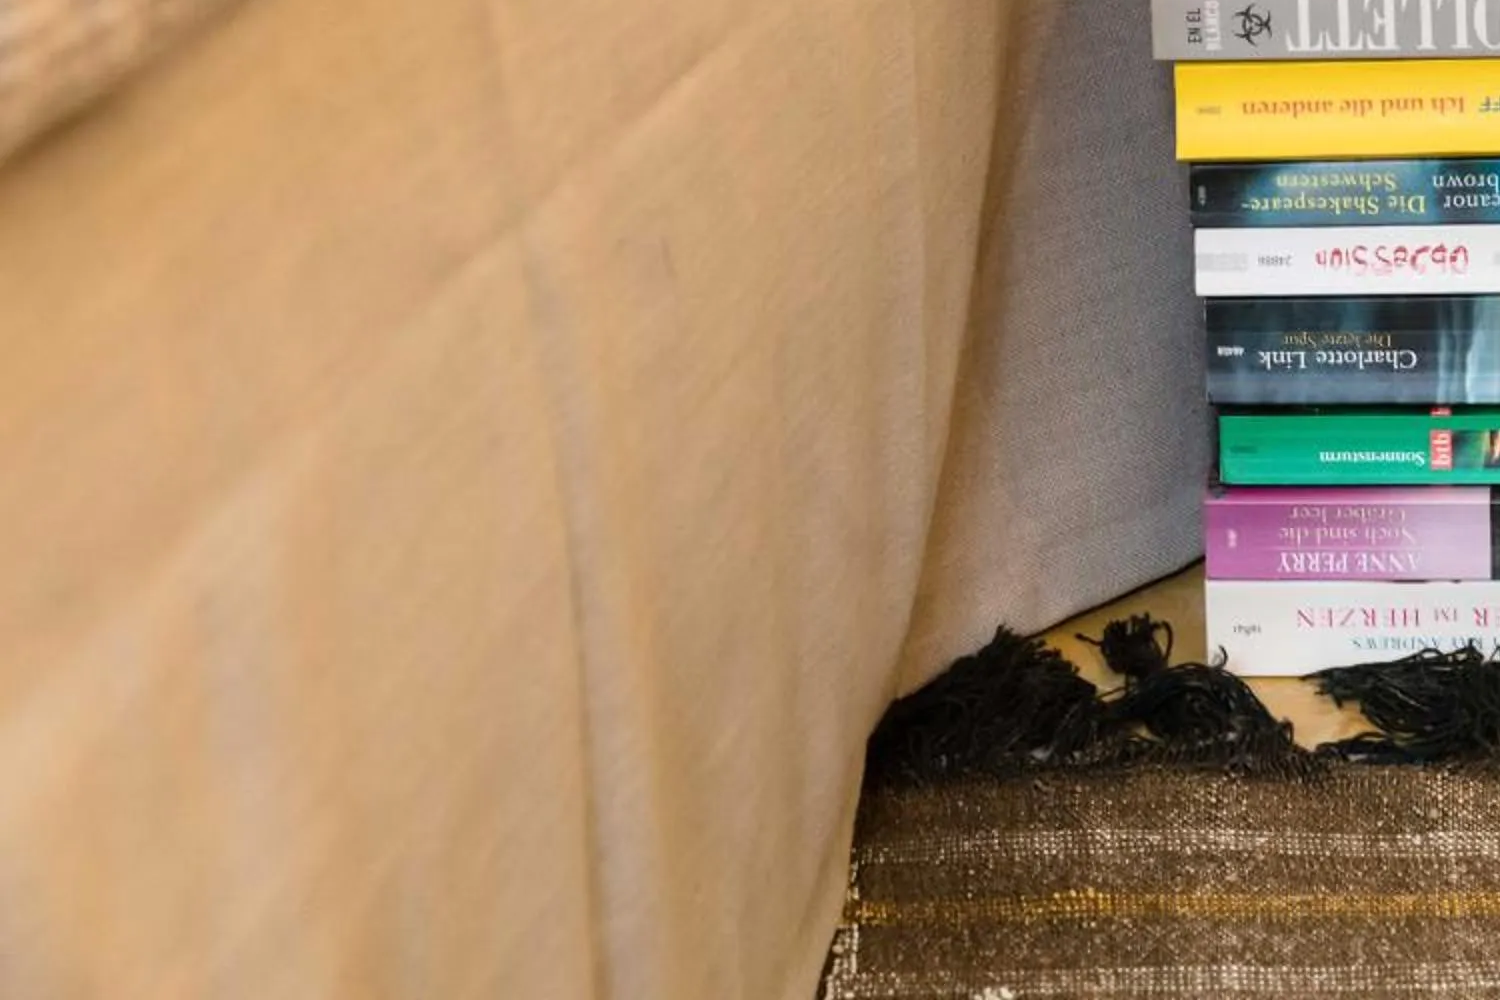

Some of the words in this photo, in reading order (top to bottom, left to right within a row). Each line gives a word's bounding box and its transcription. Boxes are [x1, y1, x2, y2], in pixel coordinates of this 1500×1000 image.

[1185, 8, 1201, 22] EL
[1188, 27, 1202, 44] EN
[1242, 100, 1334, 119] anderen
[1339, 98, 1373, 117] die
[1381, 98, 1423, 117] und
[1432, 97, 1464, 116] Ich
[1276, 172, 1396, 192] Schwestern
[1432, 174, 1499, 192] brown
[1241, 193, 1379, 216] Shakespeare-
[1388, 195, 1426, 214] Die
[1258, 350, 1306, 370] Link
[1316, 349, 1417, 369] Charlotte
[1319, 451, 1425, 466] Sonnensturm
[1432, 432, 1451, 467] btb
[1289, 507, 1327, 523] leer
[1279, 527, 1309, 547] die
[1316, 527, 1360, 546] sind
[1277, 552, 1348, 572] PERRY
[1355, 552, 1420, 573] ANNE
[1296, 608, 1419, 627] HERZEN
[1351, 637, 1441, 650] ANDREWS
